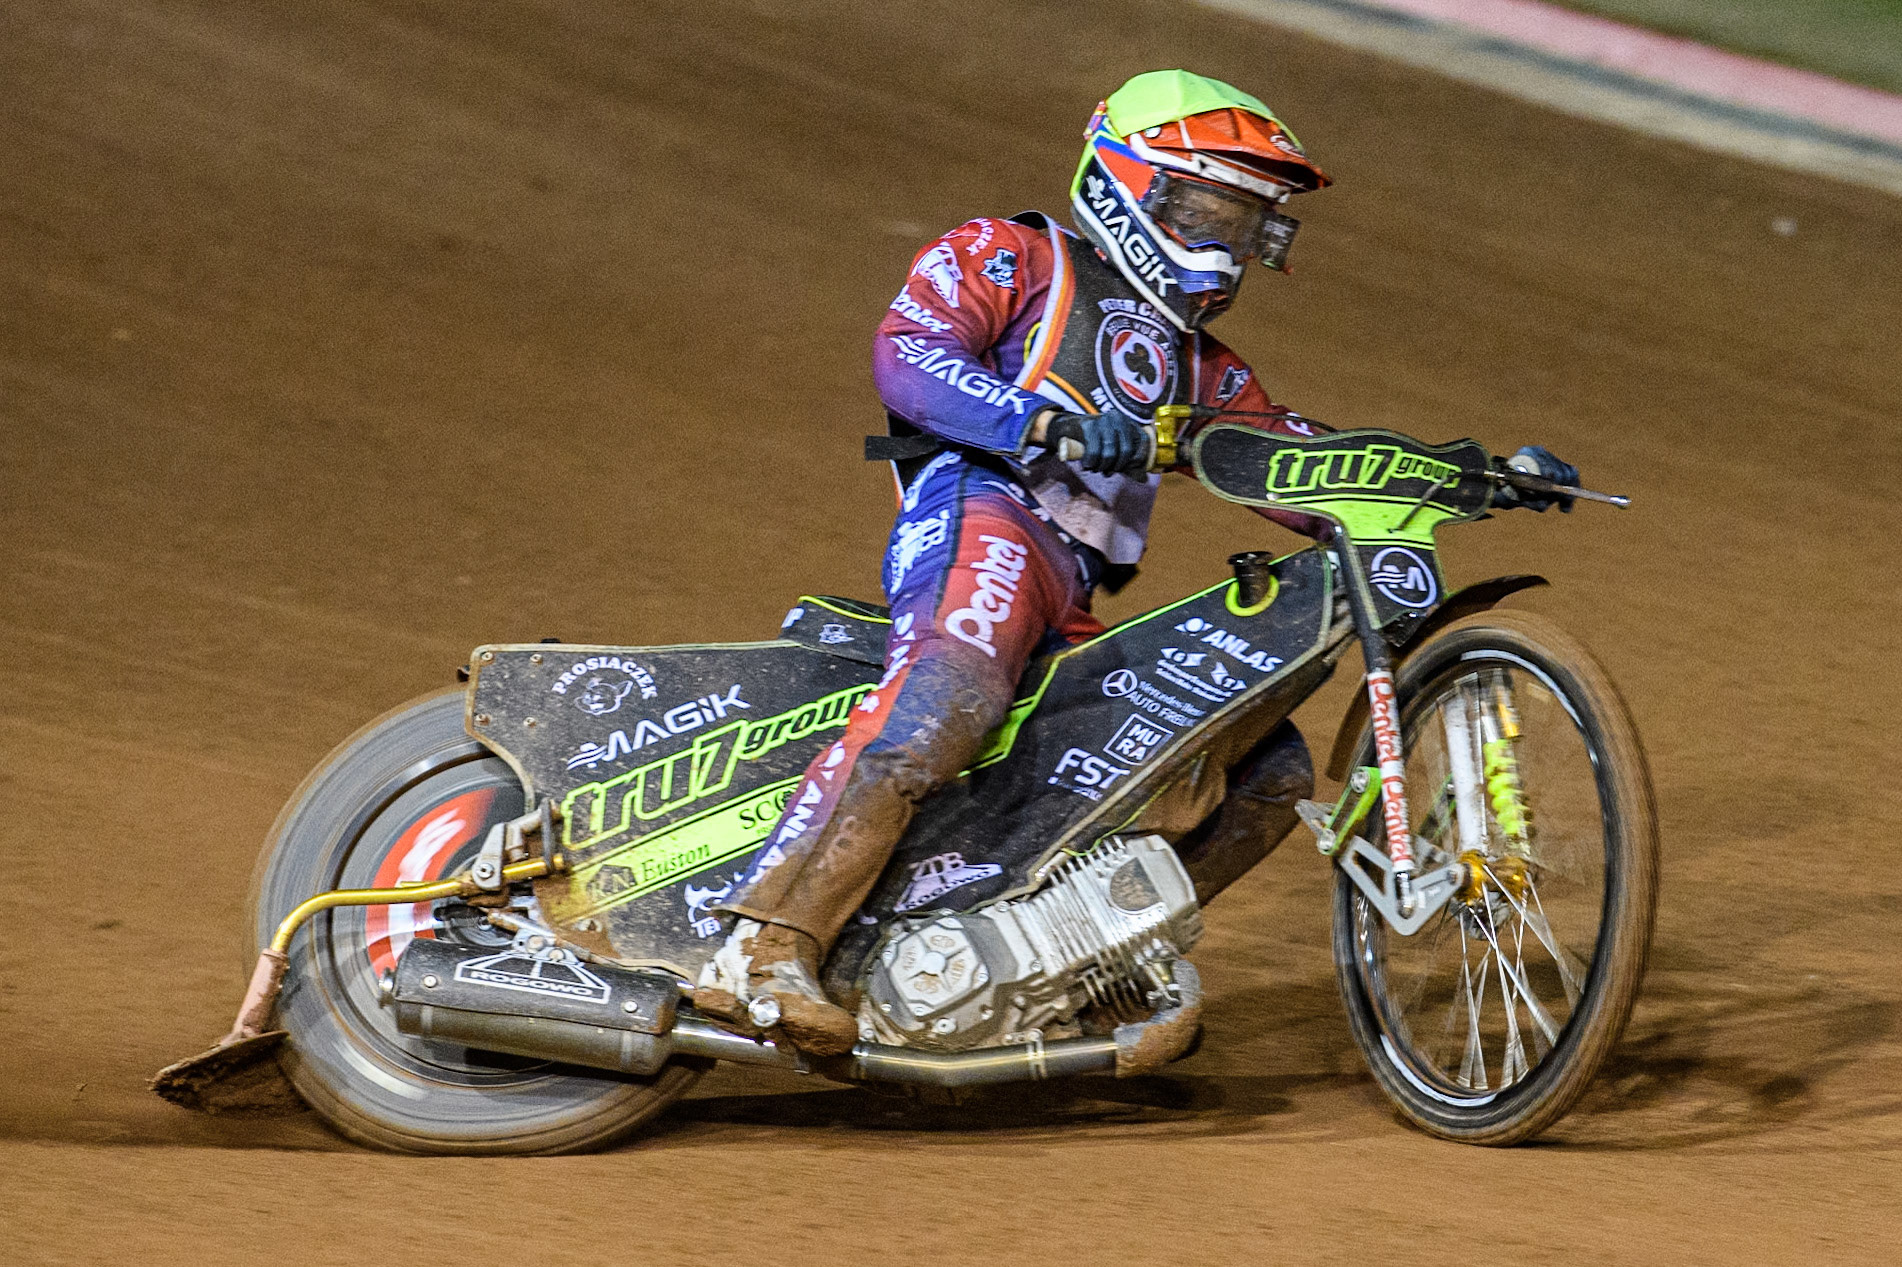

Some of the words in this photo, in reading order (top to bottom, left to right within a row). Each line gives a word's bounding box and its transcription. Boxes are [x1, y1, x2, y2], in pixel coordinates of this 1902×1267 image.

[1088, 178, 1178, 297] MAGIK
[890, 336, 1033, 414] MAGIK
[944, 534, 1028, 658] Pentel
[552, 656, 658, 699] PROSIACZEK
[1201, 629, 1283, 673] ANLAS
[568, 684, 750, 770] MAGIK
[1125, 690, 1161, 713] AUTO
[1367, 676, 1404, 768] Pentel
[1054, 747, 1131, 789] FST
[1382, 775, 1414, 861] Pentel
[641, 843, 711, 882] Euston
[470, 970, 594, 997] ROGOWO
